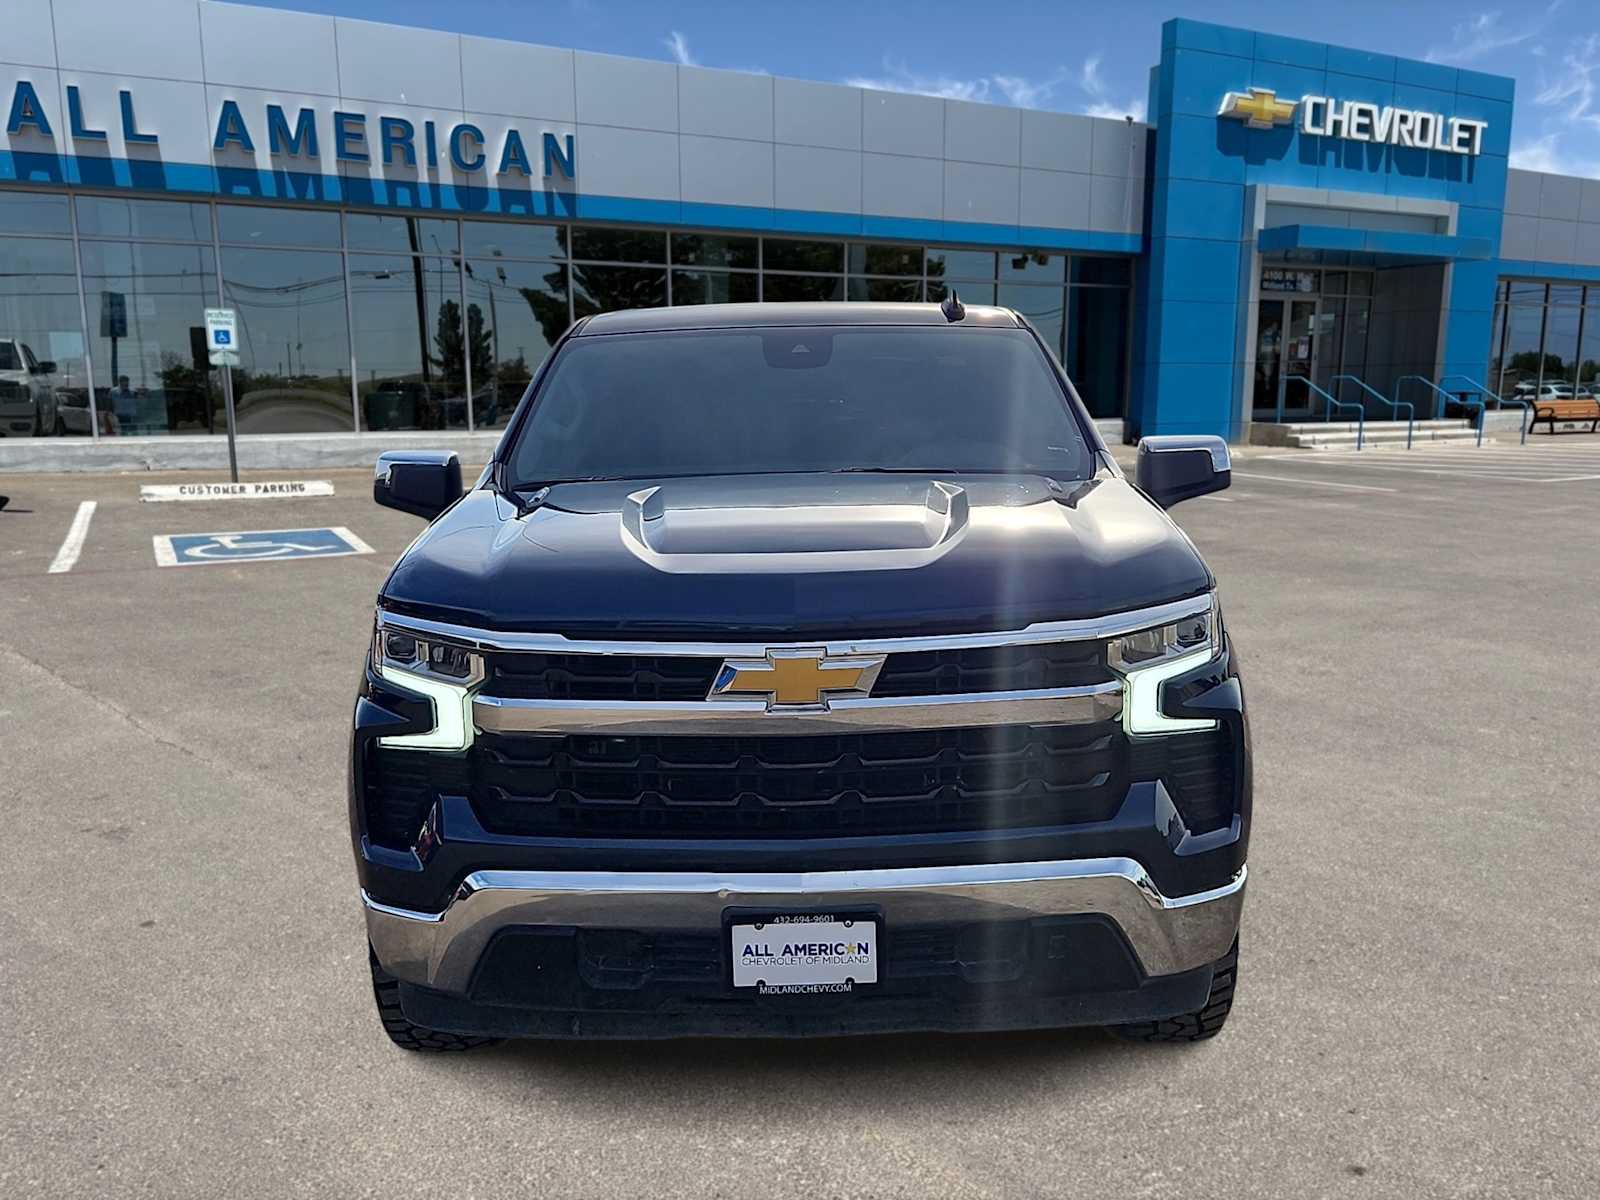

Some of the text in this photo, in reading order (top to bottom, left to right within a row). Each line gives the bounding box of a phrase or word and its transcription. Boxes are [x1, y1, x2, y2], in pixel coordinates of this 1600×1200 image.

[6, 80, 575, 180] ALL AMERICAN
[1301, 94, 1488, 156] CHEVROLET
[179, 483, 306, 495] CUSTOMER PARKING
[773, 914, 835, 924] 432-694-9601
[742, 944, 774, 957] ALL
[741, 955, 870, 966] CHEVROLET OF MIDLAND
[759, 983, 852, 995] MIDLANDCHEVY.COM
